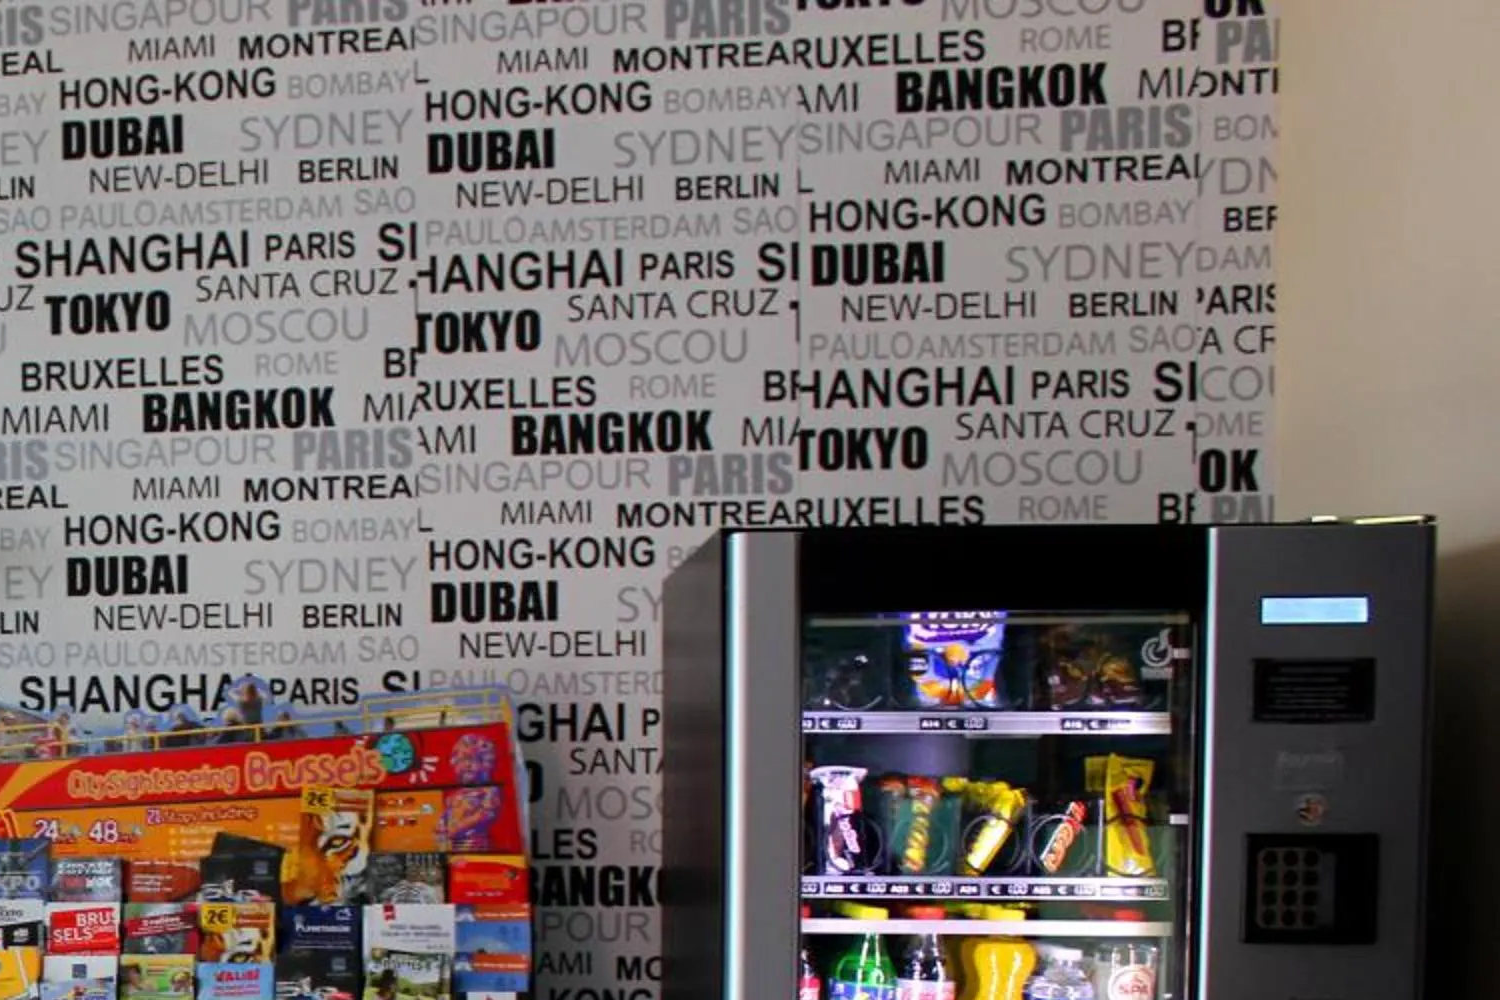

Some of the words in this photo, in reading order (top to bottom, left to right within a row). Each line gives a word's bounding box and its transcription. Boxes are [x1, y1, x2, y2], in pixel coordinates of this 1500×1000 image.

[612, 42, 798, 72] MONTREA
[1020, 26, 1112, 54] ROME
[425, 82, 652, 122] HONG-KONG
[664, 86, 792, 116] BOMBAY
[895, 62, 1107, 115] BANGKOK
[62, 114, 183, 161] DUBAI
[613, 124, 800, 169] SYDNEY
[299, 156, 398, 183] BERLIN
[884, 157, 980, 185] MIAMI
[457, 175, 644, 209] NEW-DELHI
[809, 194, 1046, 232] HONG-KONG
[15, 230, 250, 279] SHANGHAI
[265, 231, 355, 260] PARIS
[812, 242, 945, 286] DUBAI
[44, 291, 171, 336] TOKYO
[197, 274, 300, 303] SANTA
[309, 268, 397, 298] CRUZ
[840, 291, 1037, 323] NEW-DELHI
[1068, 290, 1178, 318] BERLIN
[416, 309, 540, 355] TOKYO
[568, 292, 677, 322] SANTA
[687, 289, 778, 318] CRUZ
[21, 355, 224, 391] BRUXELLES
[1031, 369, 1129, 399] PARIS
[292, 427, 413, 473] PARIS
[511, 410, 713, 456] BANGKOK
[799, 425, 928, 471] TOKYO
[955, 410, 1068, 441] SANTA
[1079, 409, 1174, 438] CRUZ
[418, 457, 651, 495] SINGAPOUR
[668, 453, 793, 496] PARIS
[941, 449, 1144, 489] MOSCOU
[133, 475, 220, 501] MIAMI
[64, 510, 280, 546] HONG-KONG
[502, 501, 592, 526] MIAMI
[429, 537, 655, 571] HONG-KONG
[67, 554, 188, 598] DUBAI
[244, 557, 417, 596] SYDNEY
[95, 603, 273, 632] NEW-DELHI
[303, 603, 402, 629] BERLIN
[431, 580, 559, 623] DUBAI
[459, 630, 647, 659] NEW-DELHI
[269, 678, 359, 706] PARIS
[245, 751, 386, 793] Brussels
[35, 820, 59, 839] 24
[89, 819, 118, 842] 48
[53, 928, 93, 942] SELS
